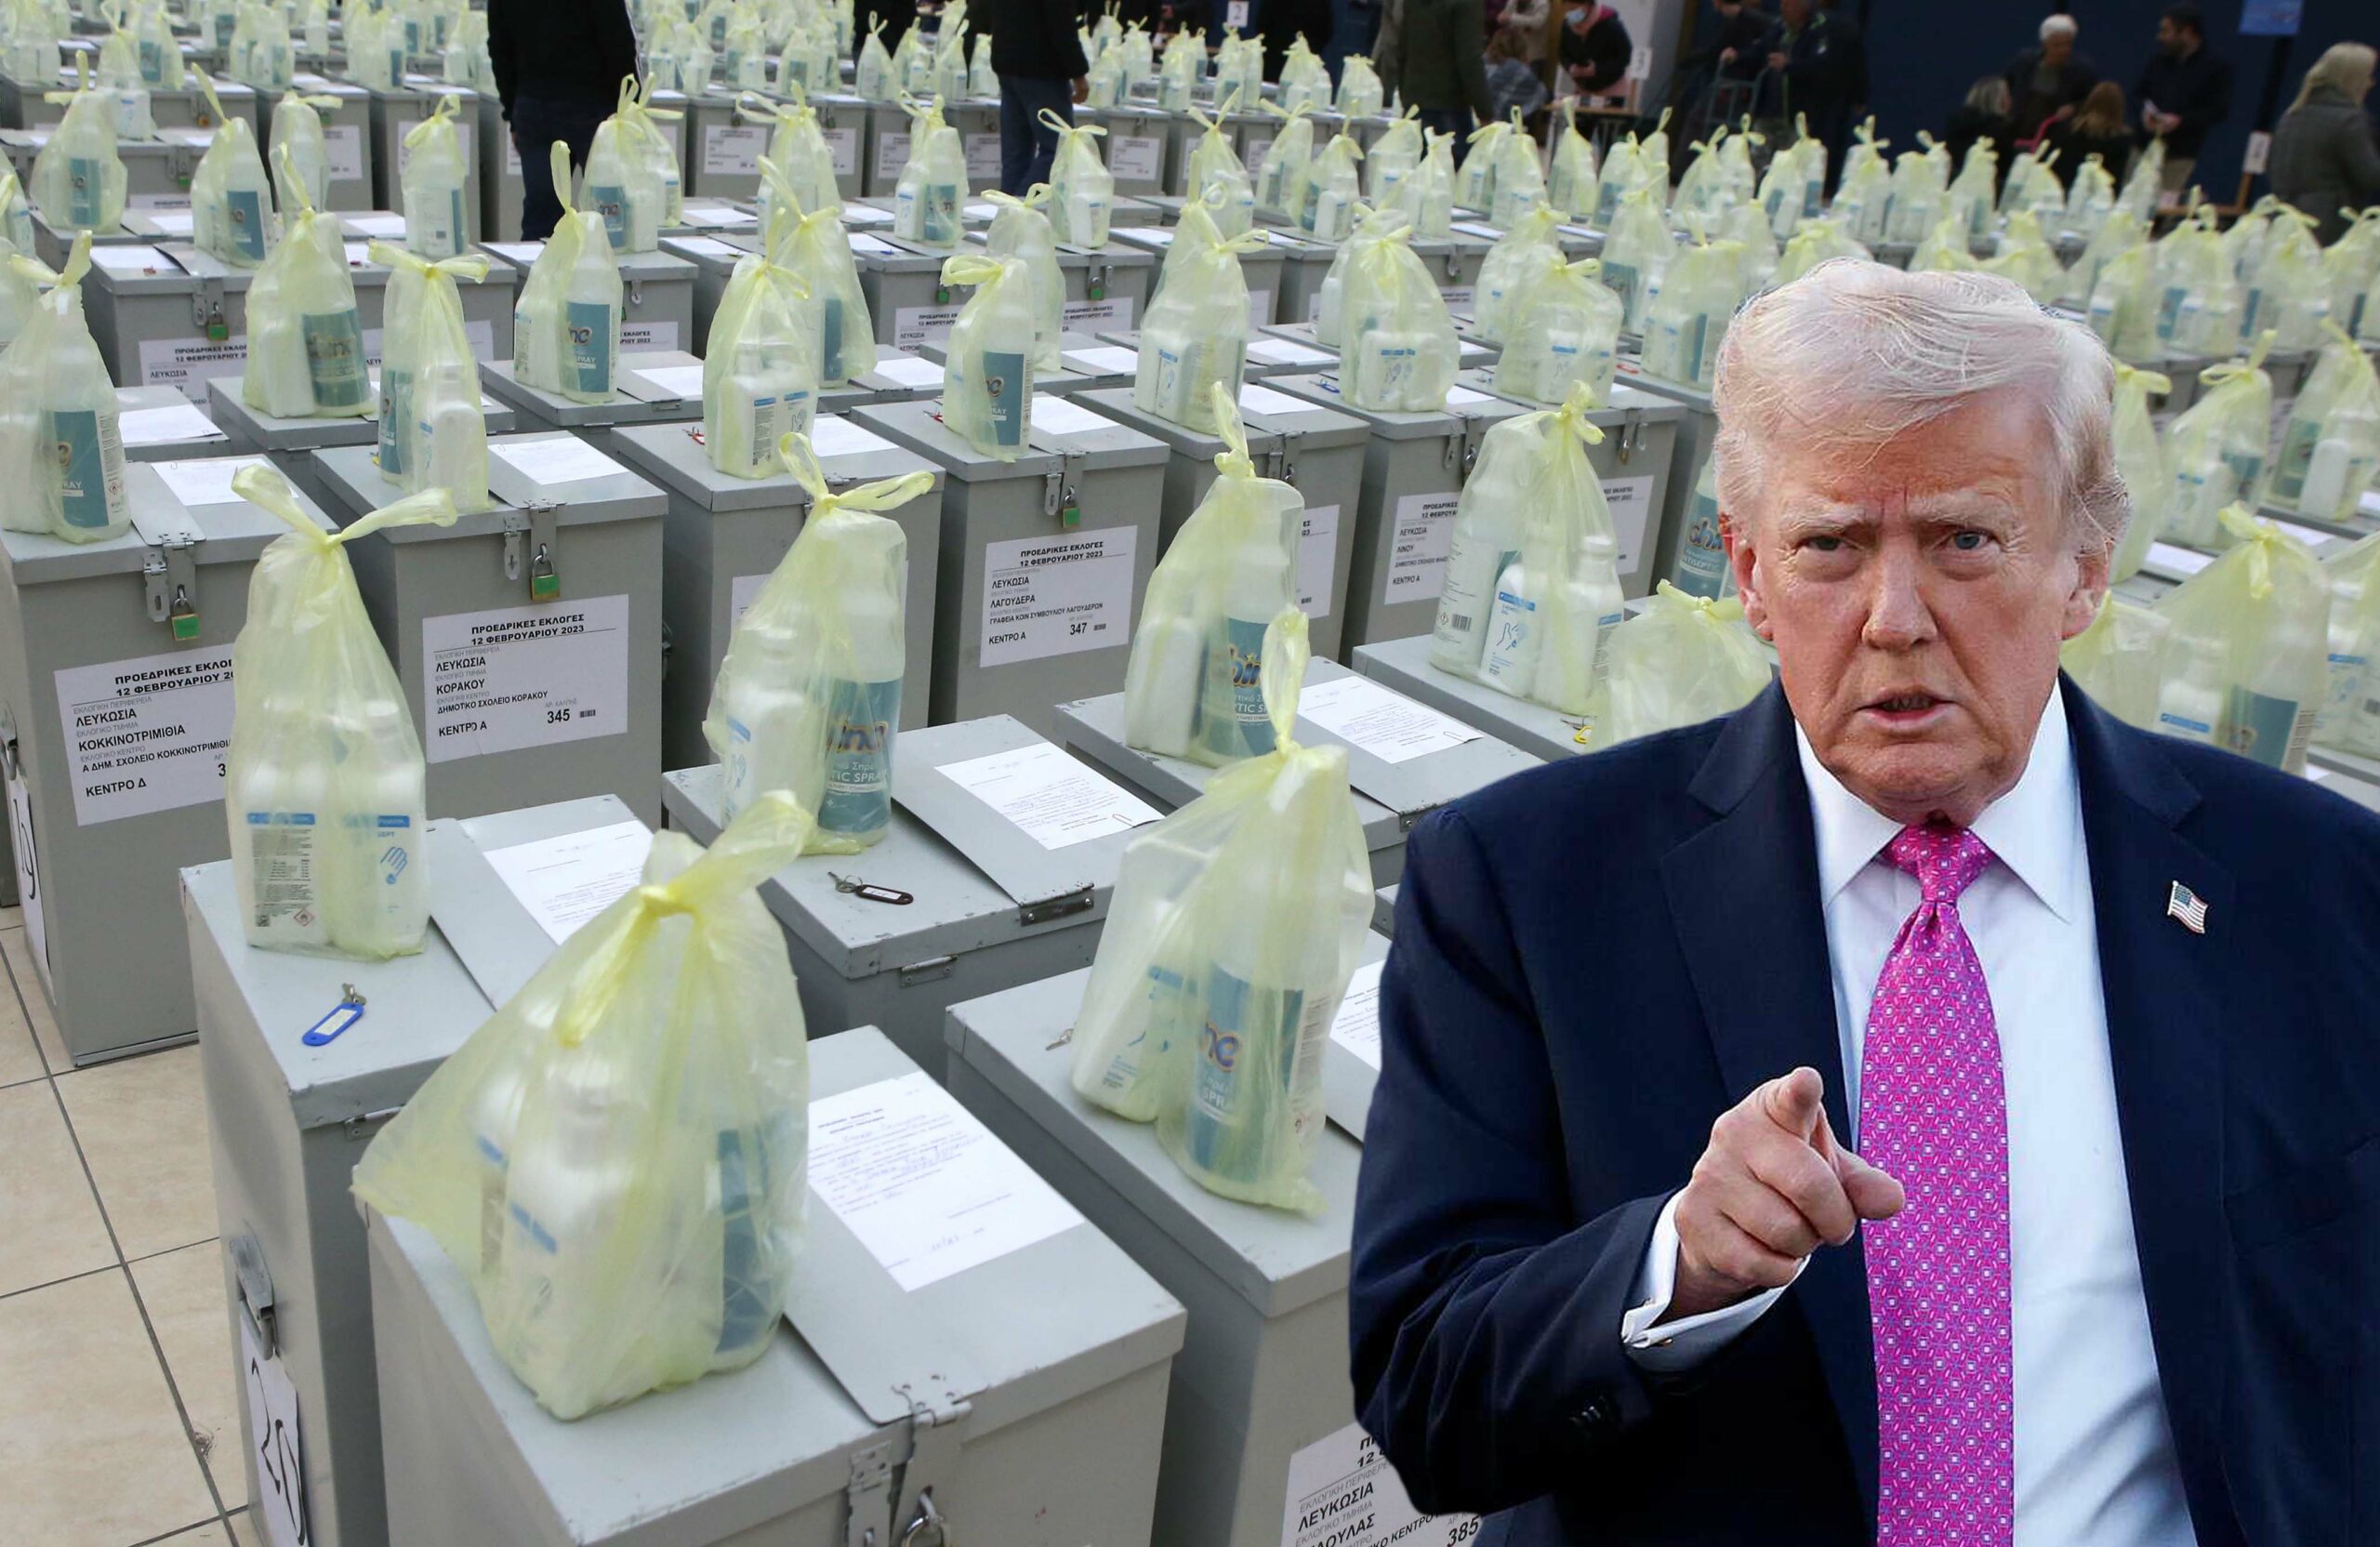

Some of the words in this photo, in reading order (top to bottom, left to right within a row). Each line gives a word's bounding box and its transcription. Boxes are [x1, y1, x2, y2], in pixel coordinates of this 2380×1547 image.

[1020, 546, 1068, 558] ΠΡΟΕΔΡΙΚΕΣ
[1070, 541, 1104, 551] ΕΚΛΟΓΕΣ
[1030, 553, 1084, 566] ΦΕΒΡΟΥΑΡΙΟΥ
[1085, 550, 1103, 559] 2023
[991, 576, 1029, 588] ΛΕΥΚΩΣΙΑ
[990, 594, 1036, 609] ΛΑΓΟΥΔΕΡΑ
[471, 620, 536, 635] ΠΡΟΕΔΡΙΚΕΣ
[538, 614, 585, 627] ΕΚΛΟΓΕΣ
[989, 613, 1014, 625] ΓΡΑΦΕΙΑ
[471, 637, 483, 646] 12
[485, 628, 559, 644] ΦΕΒΡΟΥΑΡΙΟΥ
[561, 625, 585, 635] 2023
[1069, 622, 1088, 636] 347
[988, 634, 1019, 645] ΚΕΝΤΡΟ
[1020, 631, 1026, 640] Α
[435, 656, 486, 673] ΛΕΥΚΩΣΙΑ
[114, 666, 192, 685] ΠΡΟΕΔΡΙΚΕΣ
[116, 688, 131, 697] 12
[134, 673, 221, 694] ΦΕΒΡΟΥΑΡΙΟΥ
[436, 679, 485, 695] ΚΟΡΑΚΟΥ
[437, 701, 477, 715] ΔΗΜΟΤΚΟ
[478, 695, 510, 708] ΣΧΟΛΕΙΟ
[511, 691, 549, 704] ΚΟΡΑΚΟΥ
[1234, 703, 1255, 713] TIC
[75, 708, 138, 728] ΛΕΥΚΩΣΙΑ
[547, 708, 570, 724] 345
[439, 721, 477, 737] ΚΕΝΤΡΟ
[480, 721, 487, 731] Α
[78, 724, 187, 752] ΚΟΚΚΙΝΟΤΡΙΜΙΘΙΑ
[83, 764, 89, 773] Α
[91, 760, 114, 772] ΔΗΜ.
[116, 752, 155, 768] ΣΧΟΛΕΙΟ
[218, 762, 226, 777] 3
[86, 780, 136, 798] ΚΕΝΤΡΟ
[138, 777, 147, 787] Δ
[1357, 1452, 1375, 1468] 12
[1298, 1481, 1374, 1532] ΛΕΥΚΩΣΙΑ
[1299, 1486, 1344, 1514] ΕΚΛΟΓΙΚΗ
[1342, 1500, 1373, 1522] ΤΜΗΜΑ
[1447, 1514, 1480, 1547] 385
